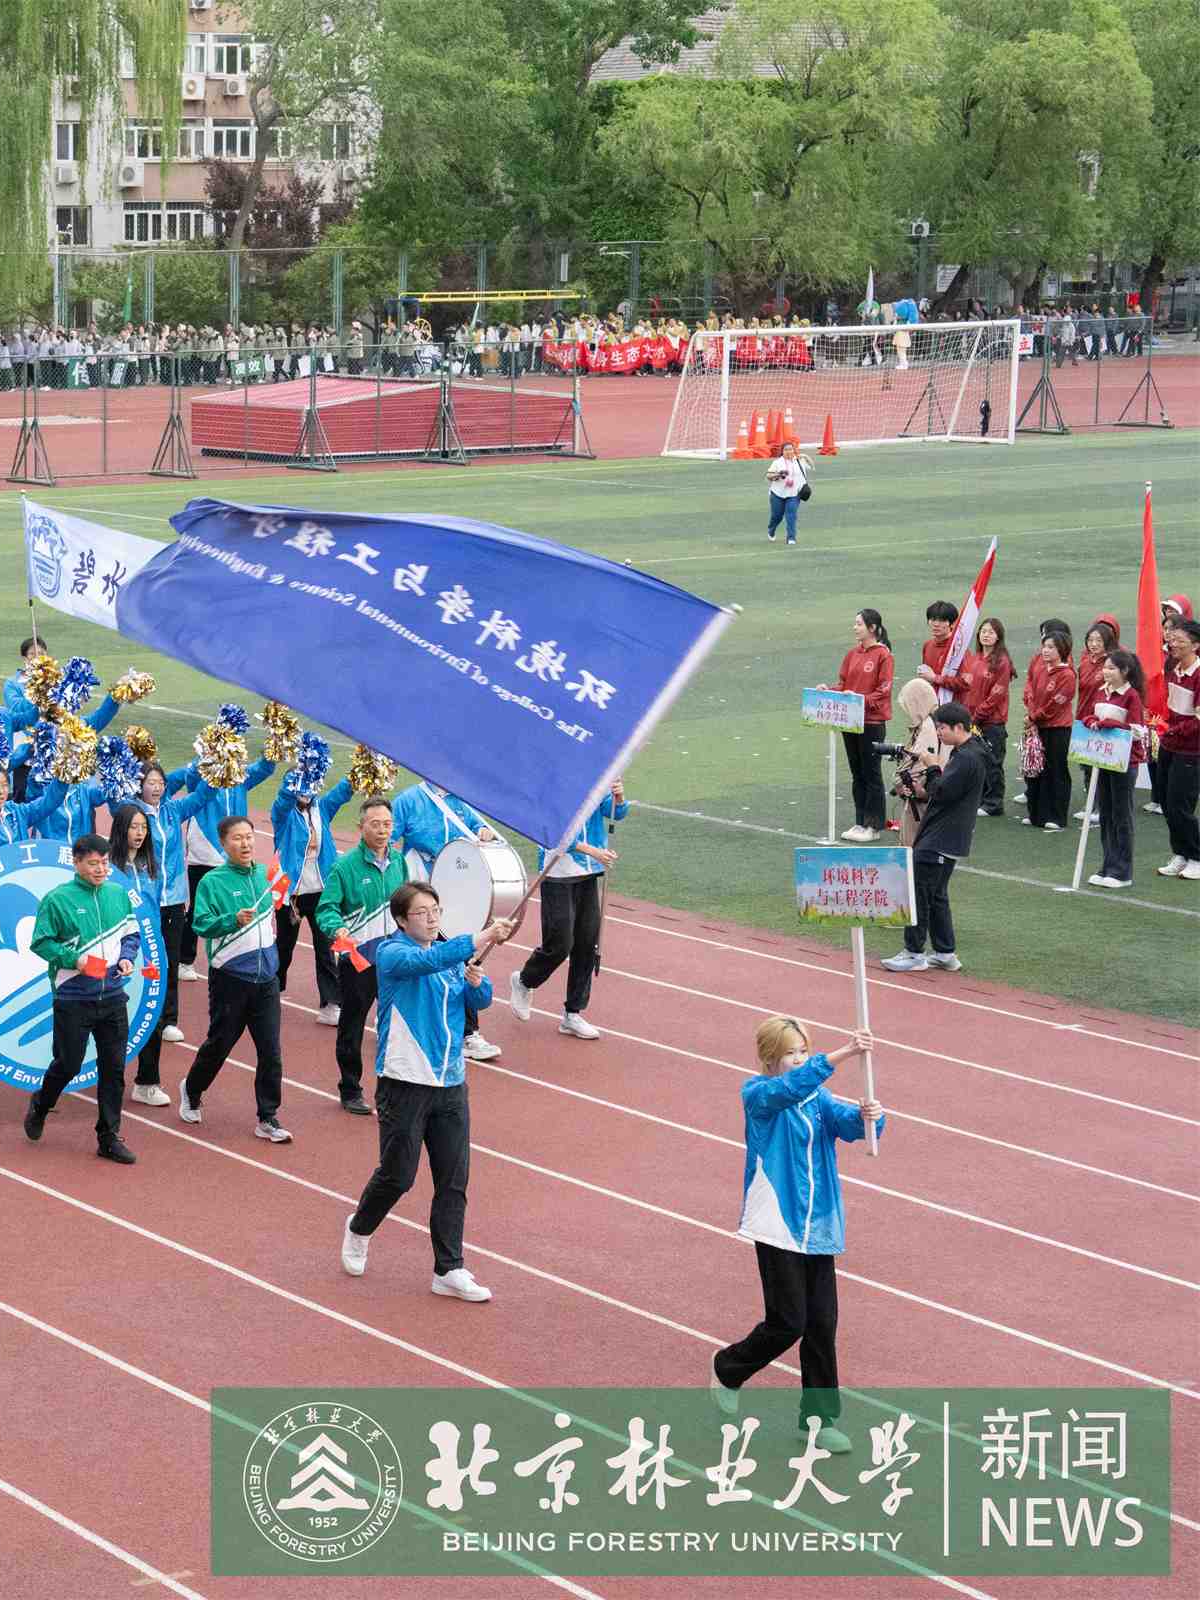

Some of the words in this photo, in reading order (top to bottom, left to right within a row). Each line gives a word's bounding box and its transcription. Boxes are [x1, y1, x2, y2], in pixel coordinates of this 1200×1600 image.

[823, 867, 879, 885] 环境科学
[816, 887, 889, 907] 与工程学院
[142, 917, 161, 997] Enneering
[146, 1000, 157, 1010] &
[125, 1012, 153, 1055] cience
